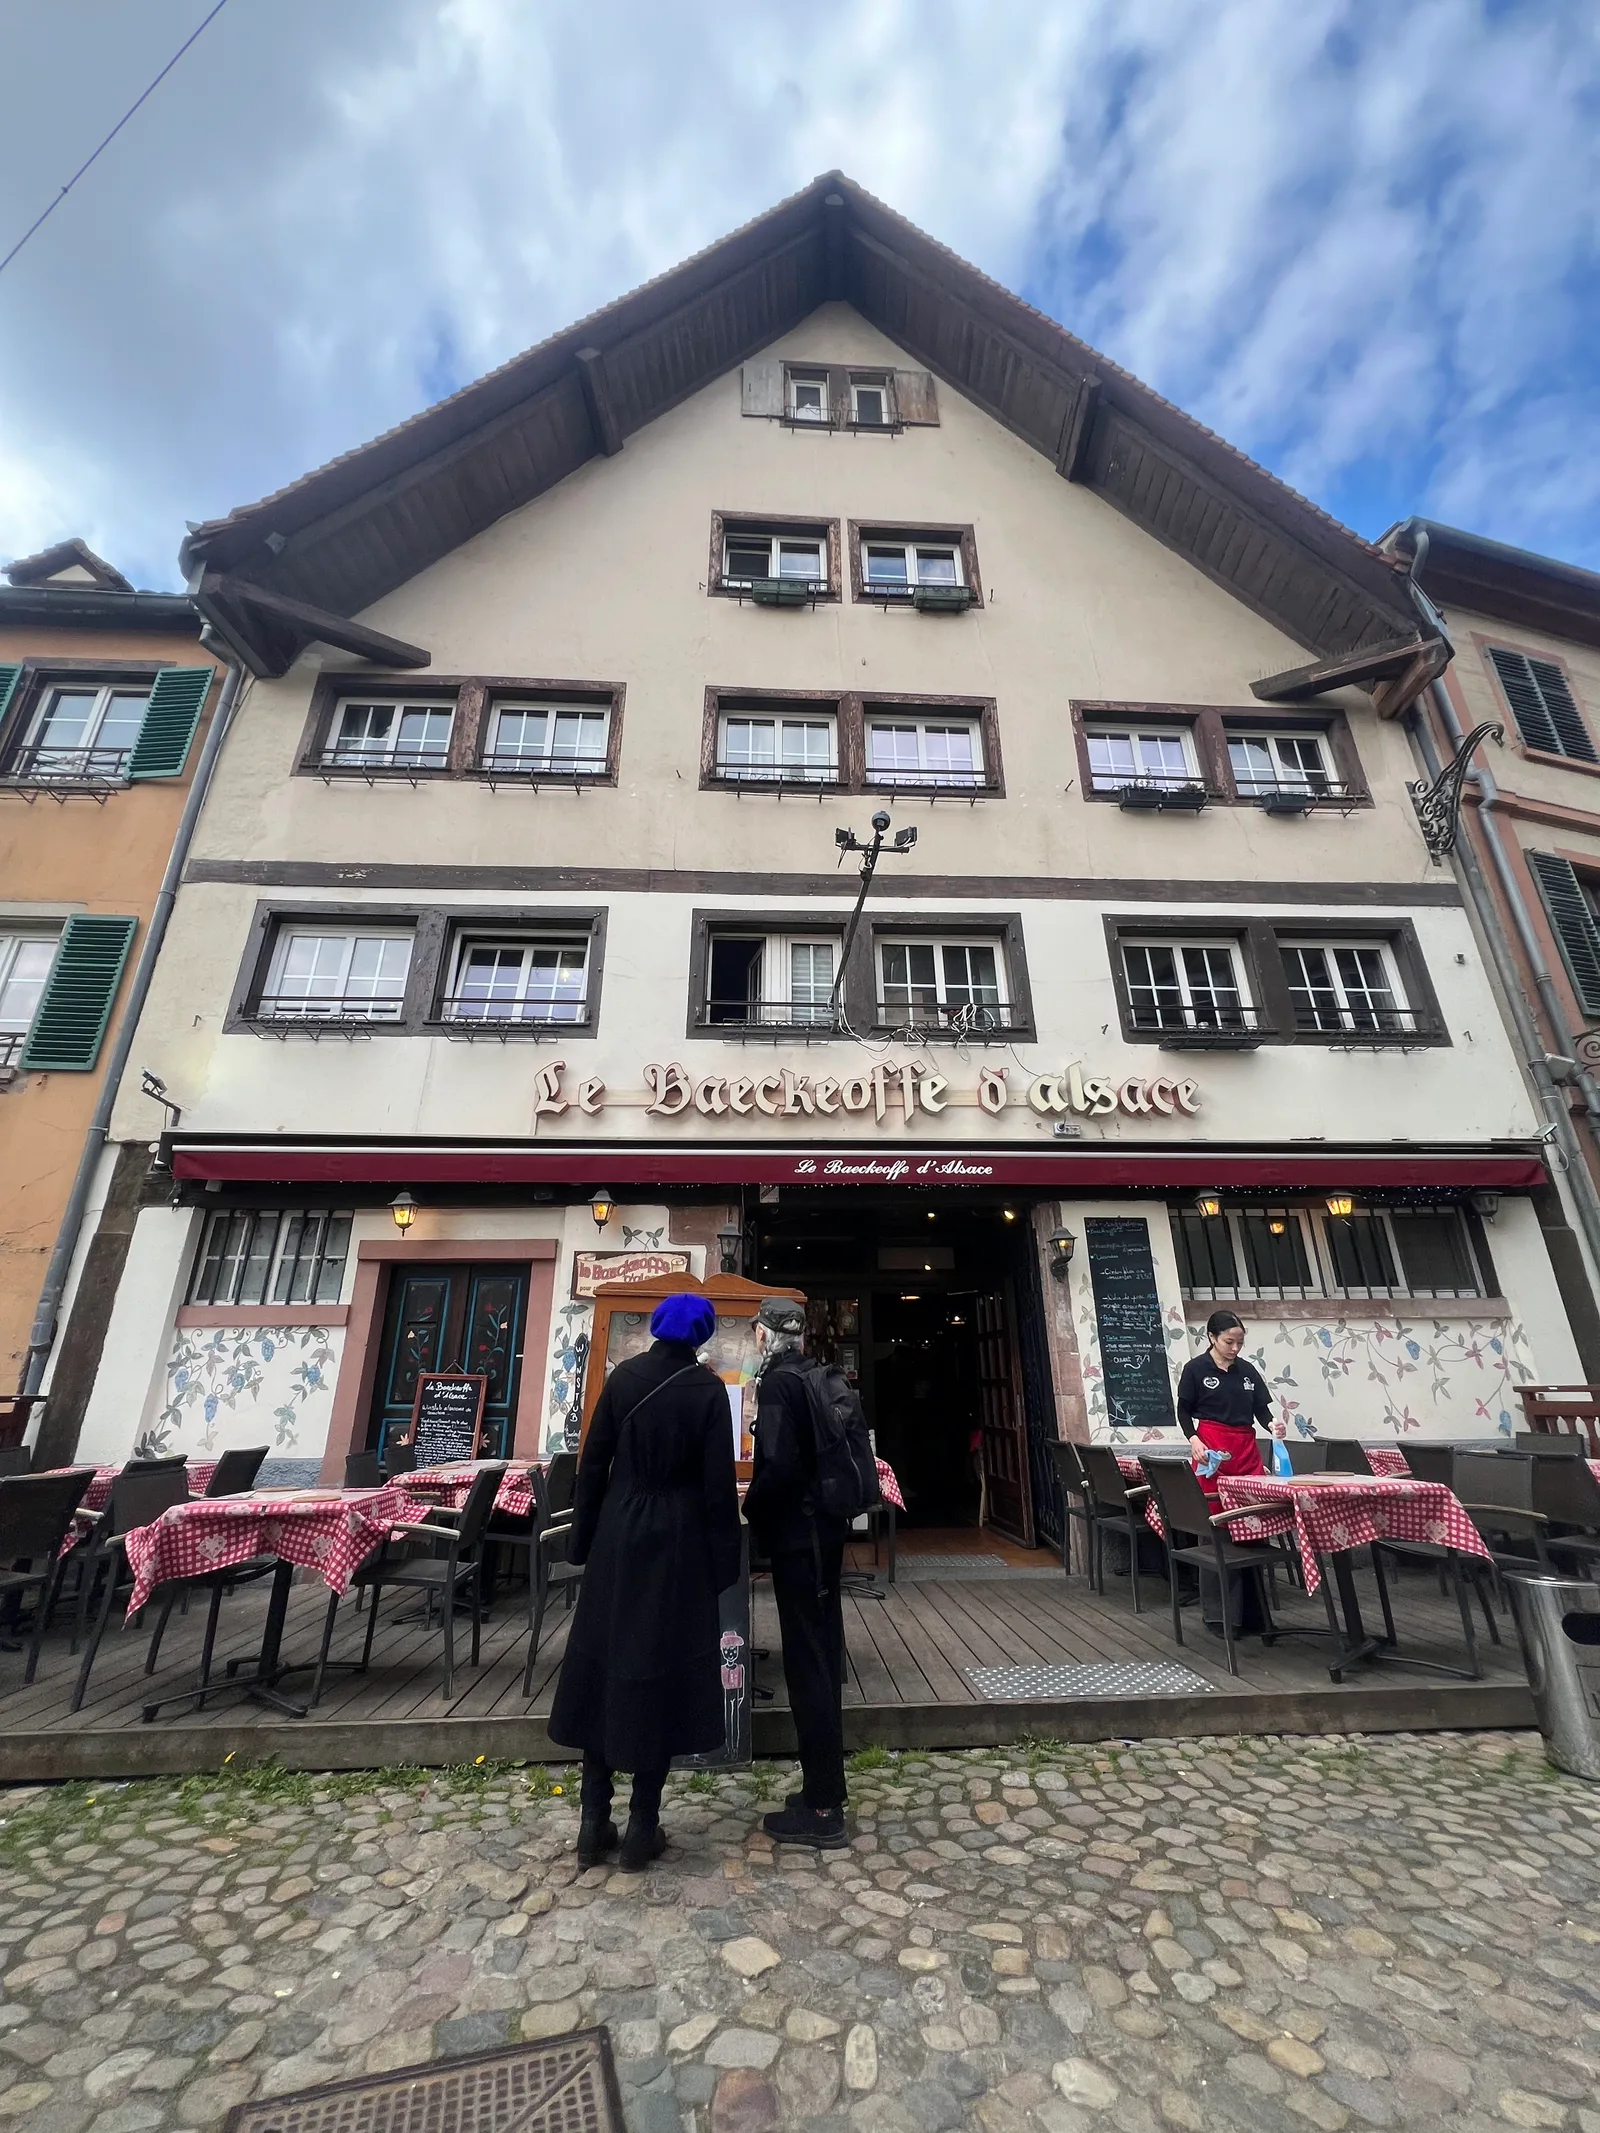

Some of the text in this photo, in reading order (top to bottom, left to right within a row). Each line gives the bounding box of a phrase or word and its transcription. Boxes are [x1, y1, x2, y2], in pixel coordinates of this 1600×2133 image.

[534, 1060, 605, 1117] Le
[643, 1060, 949, 1125] Baeckeoffe
[794, 1159, 993, 1180] Le Baeckeoffe d'Alsace
